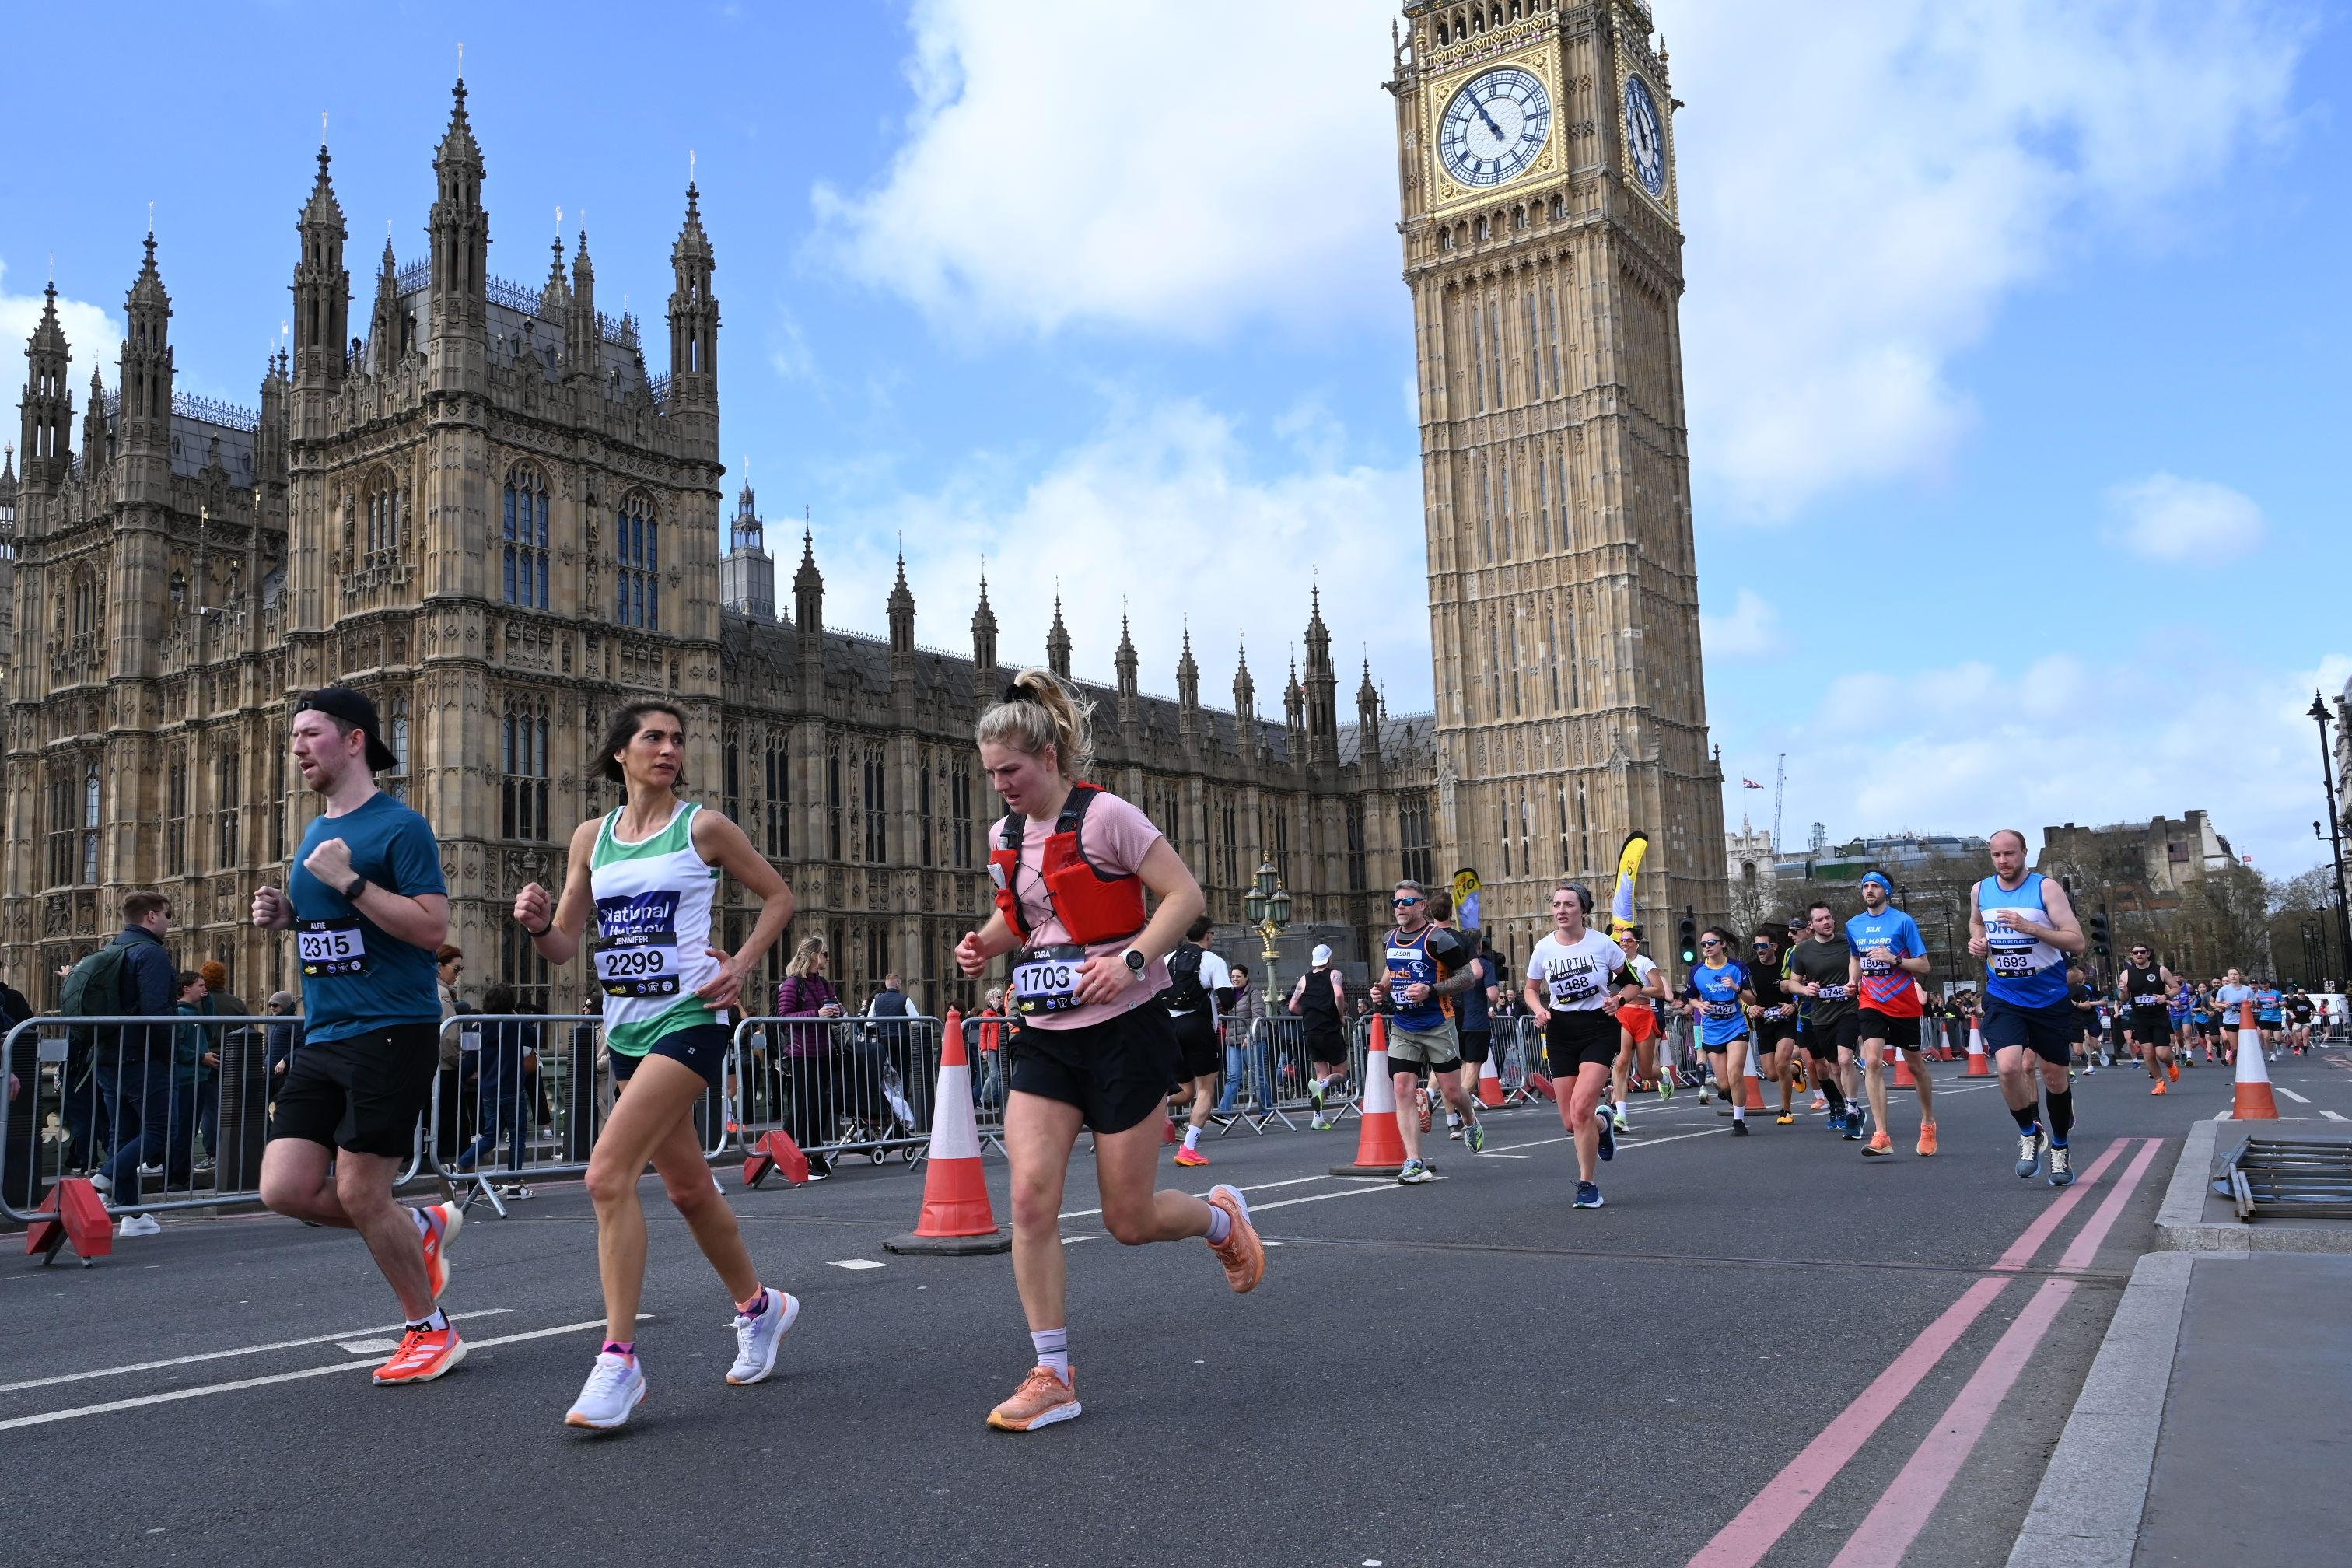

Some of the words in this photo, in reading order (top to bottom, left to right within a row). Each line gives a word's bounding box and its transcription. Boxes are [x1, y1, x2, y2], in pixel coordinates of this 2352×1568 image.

[601, 901, 670, 922] National
[303, 935, 350, 957] 2315
[615, 935, 649, 945] JENNIFER
[1034, 950, 1051, 959] TARA
[606, 950, 663, 976] 2299
[1549, 955, 1598, 976] MARTHA
[1862, 959, 1885, 968] 1804
[1997, 956, 2028, 968] 1693
[1021, 966, 1070, 992] 1703
[1556, 976, 1589, 993] 1488
[1822, 987, 1844, 997] 1748
[1713, 1005, 1732, 1013] 1427
